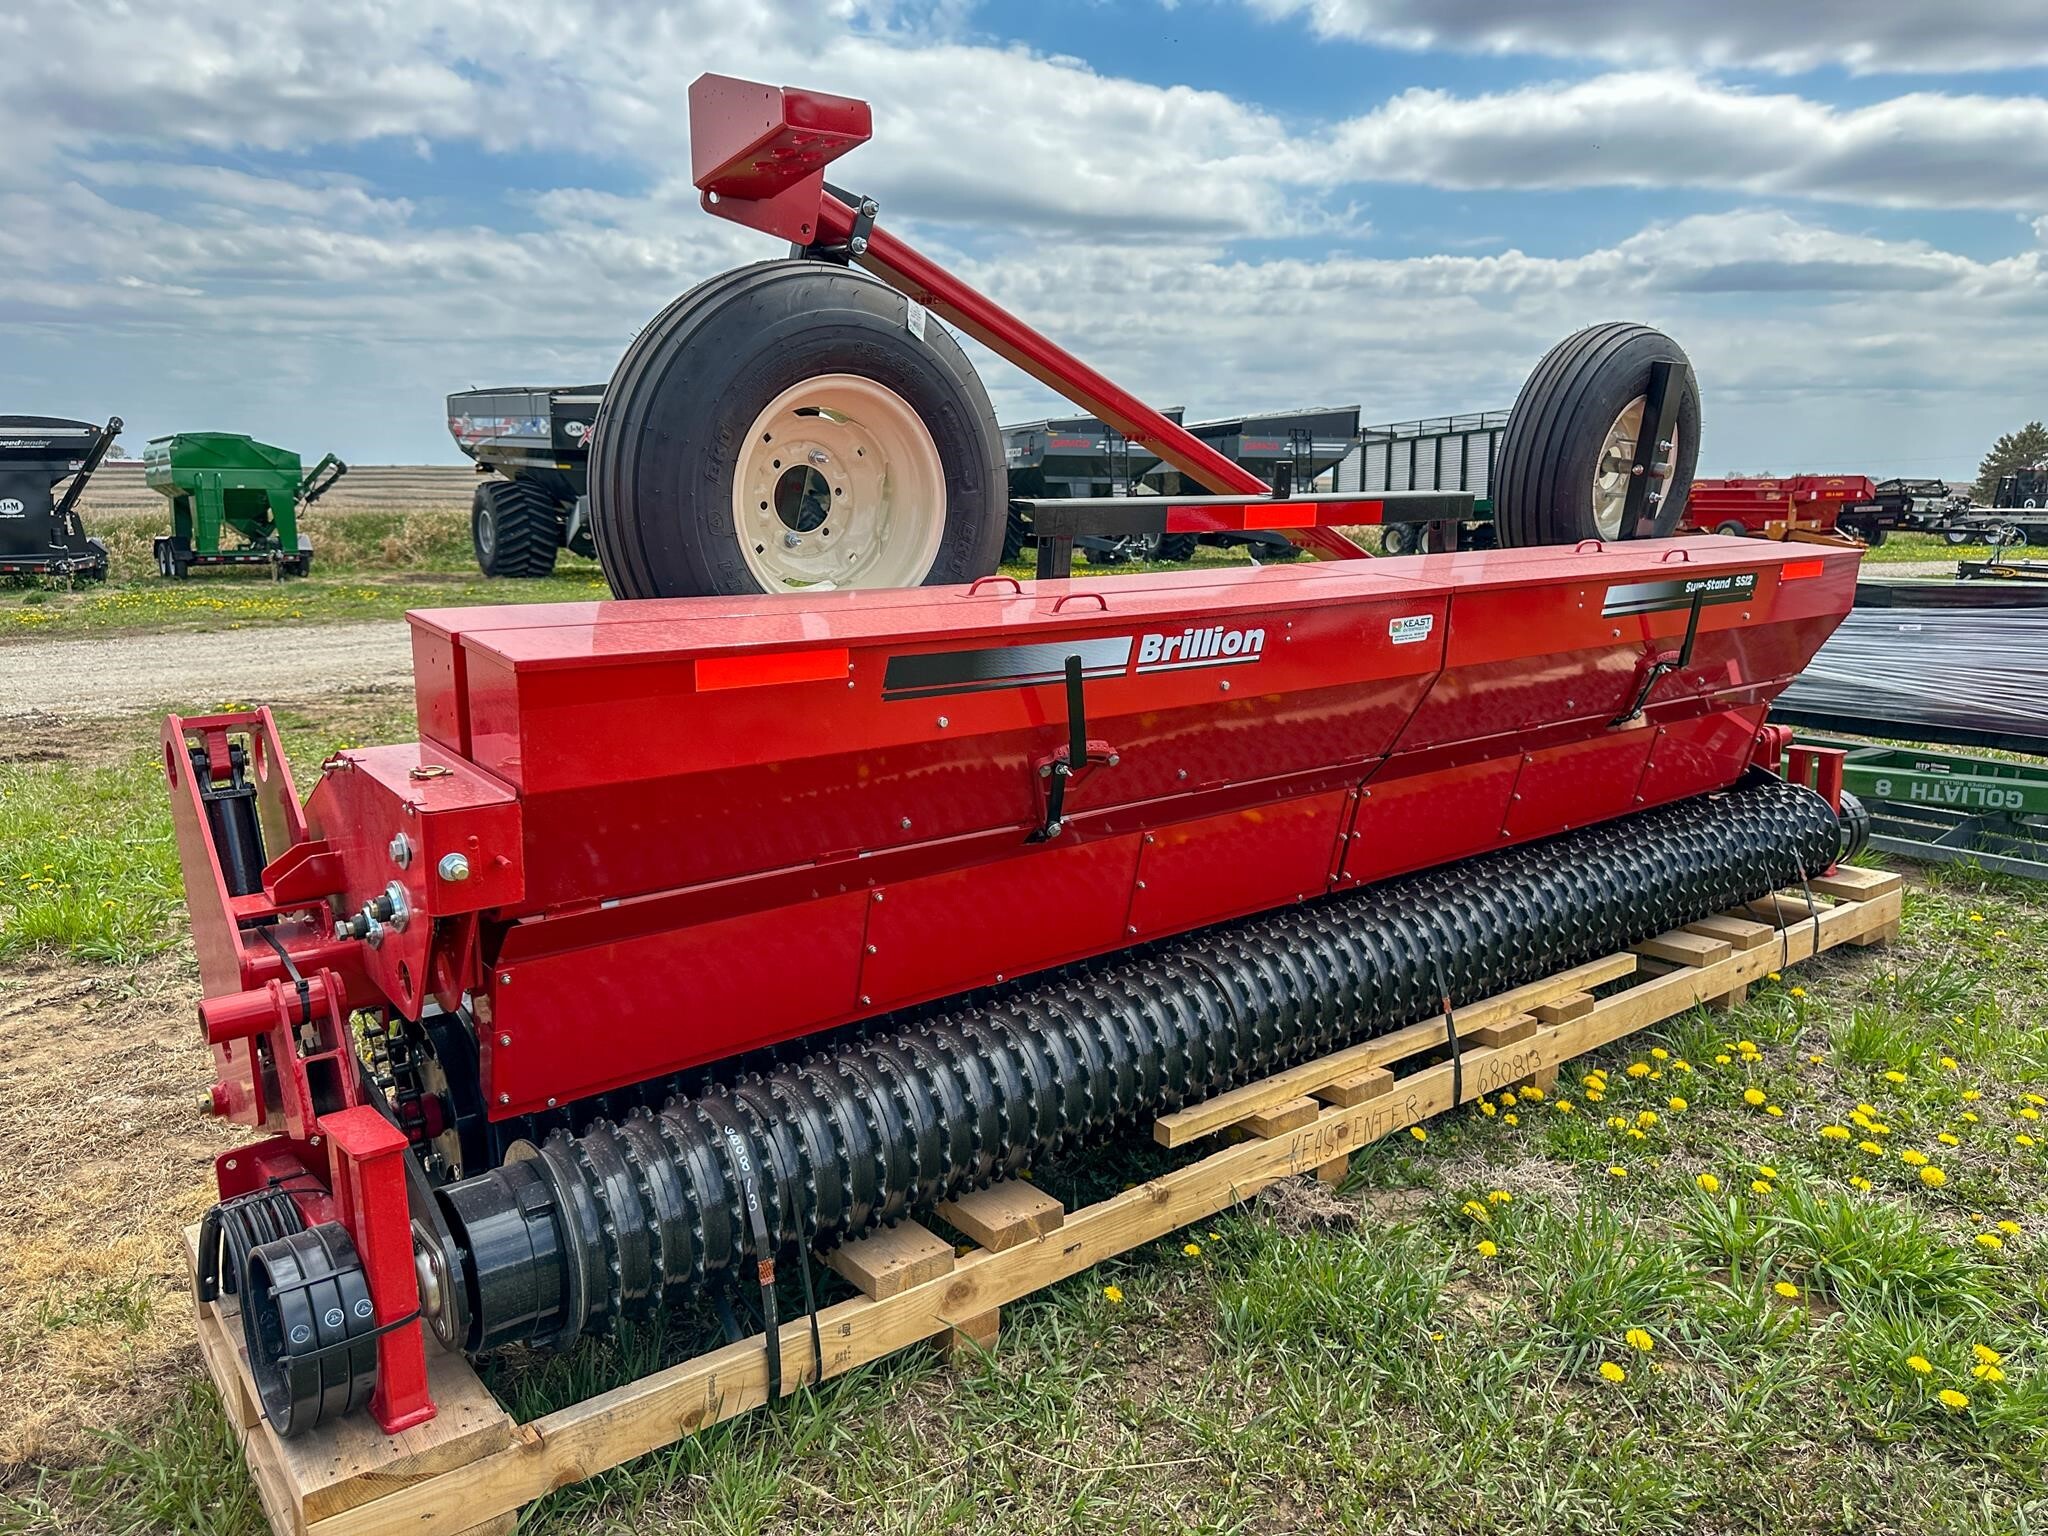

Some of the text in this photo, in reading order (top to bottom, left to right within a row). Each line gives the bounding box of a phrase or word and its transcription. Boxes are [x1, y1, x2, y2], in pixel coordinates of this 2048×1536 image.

[1403, 616, 1432, 628] KEAST
[1137, 625, 1266, 664] Brillion
[1875, 779, 2024, 809] GOLIATH 8
[1289, 1121, 1348, 1174] KEAST
[1476, 1049, 1542, 1095] 680813
[724, 1125, 758, 1212] 680813
